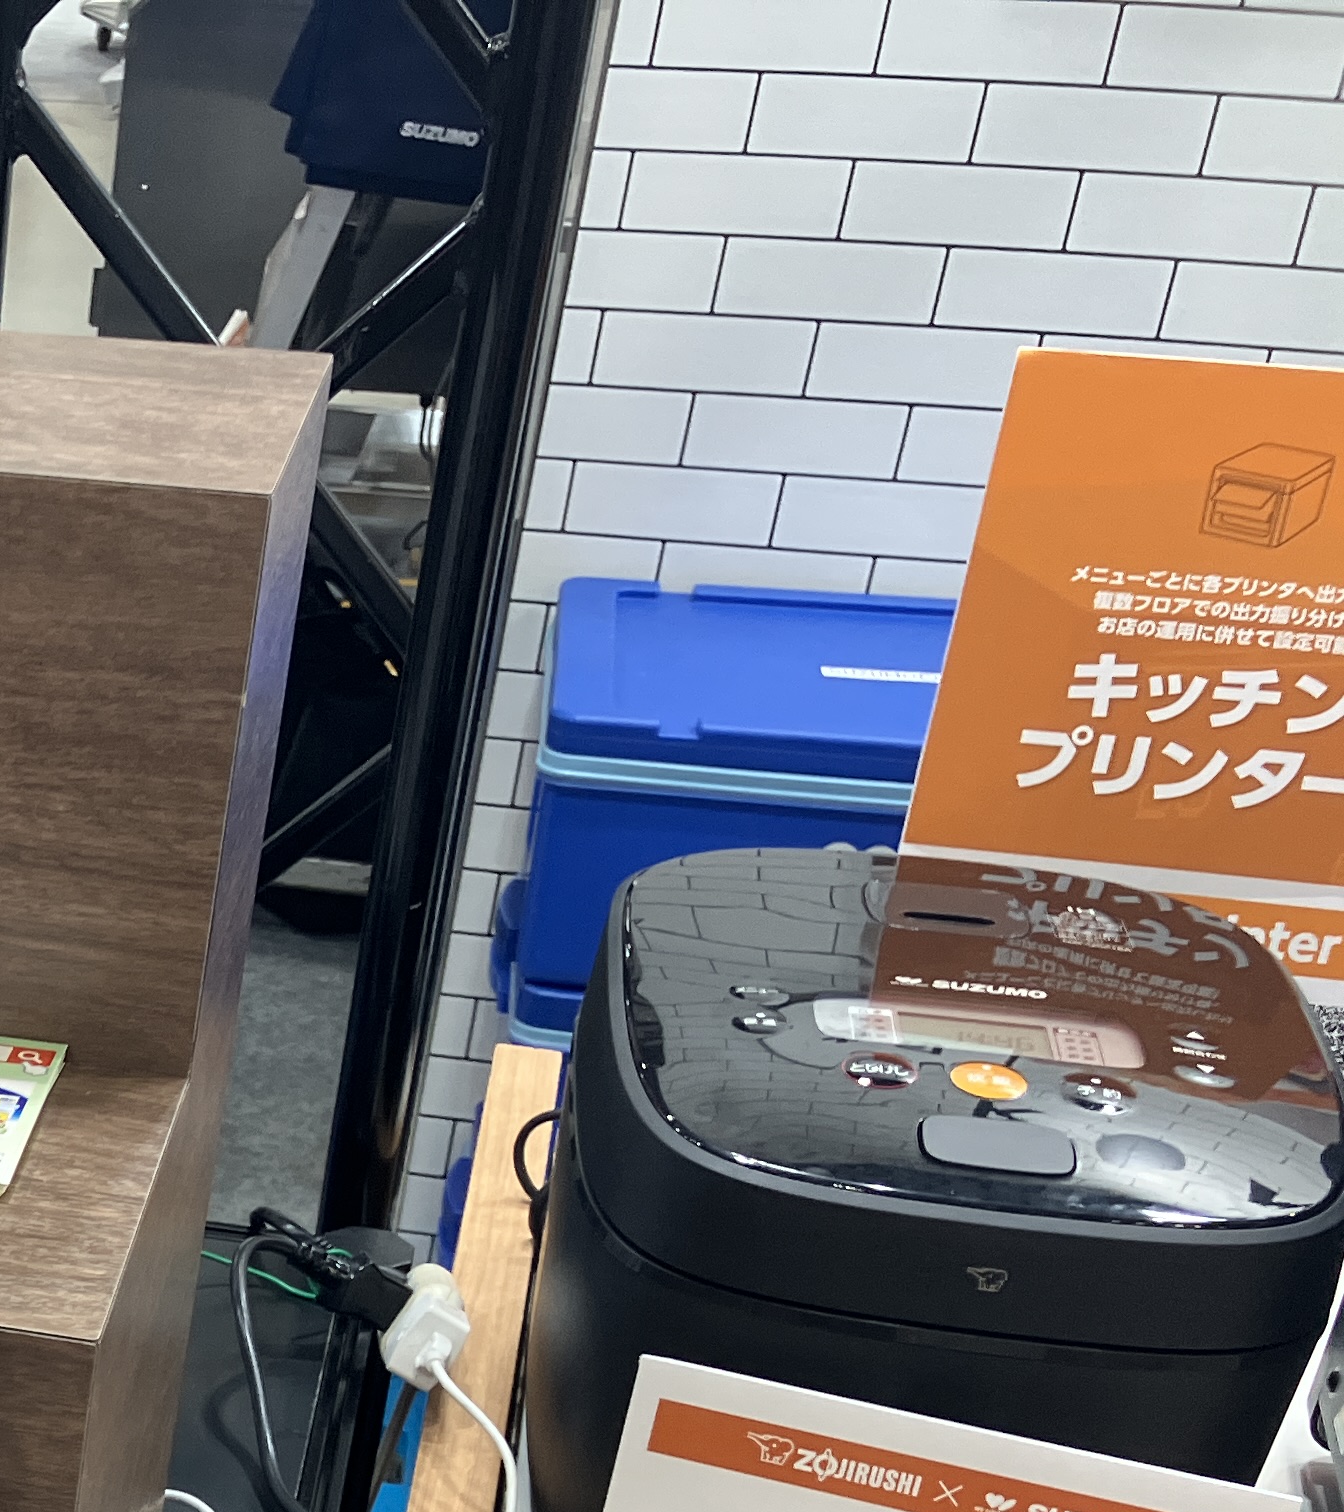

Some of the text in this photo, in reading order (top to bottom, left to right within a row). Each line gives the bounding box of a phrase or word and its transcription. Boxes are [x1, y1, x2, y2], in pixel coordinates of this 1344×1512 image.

[399, 121, 480, 147] SUZUMO
[1067, 652, 1344, 734] キッチン
[1227, 914, 1343, 965] ter
[932, 978, 1048, 999] SUZUMO
[793, 1448, 923, 1498] ZOJIRUSHI
